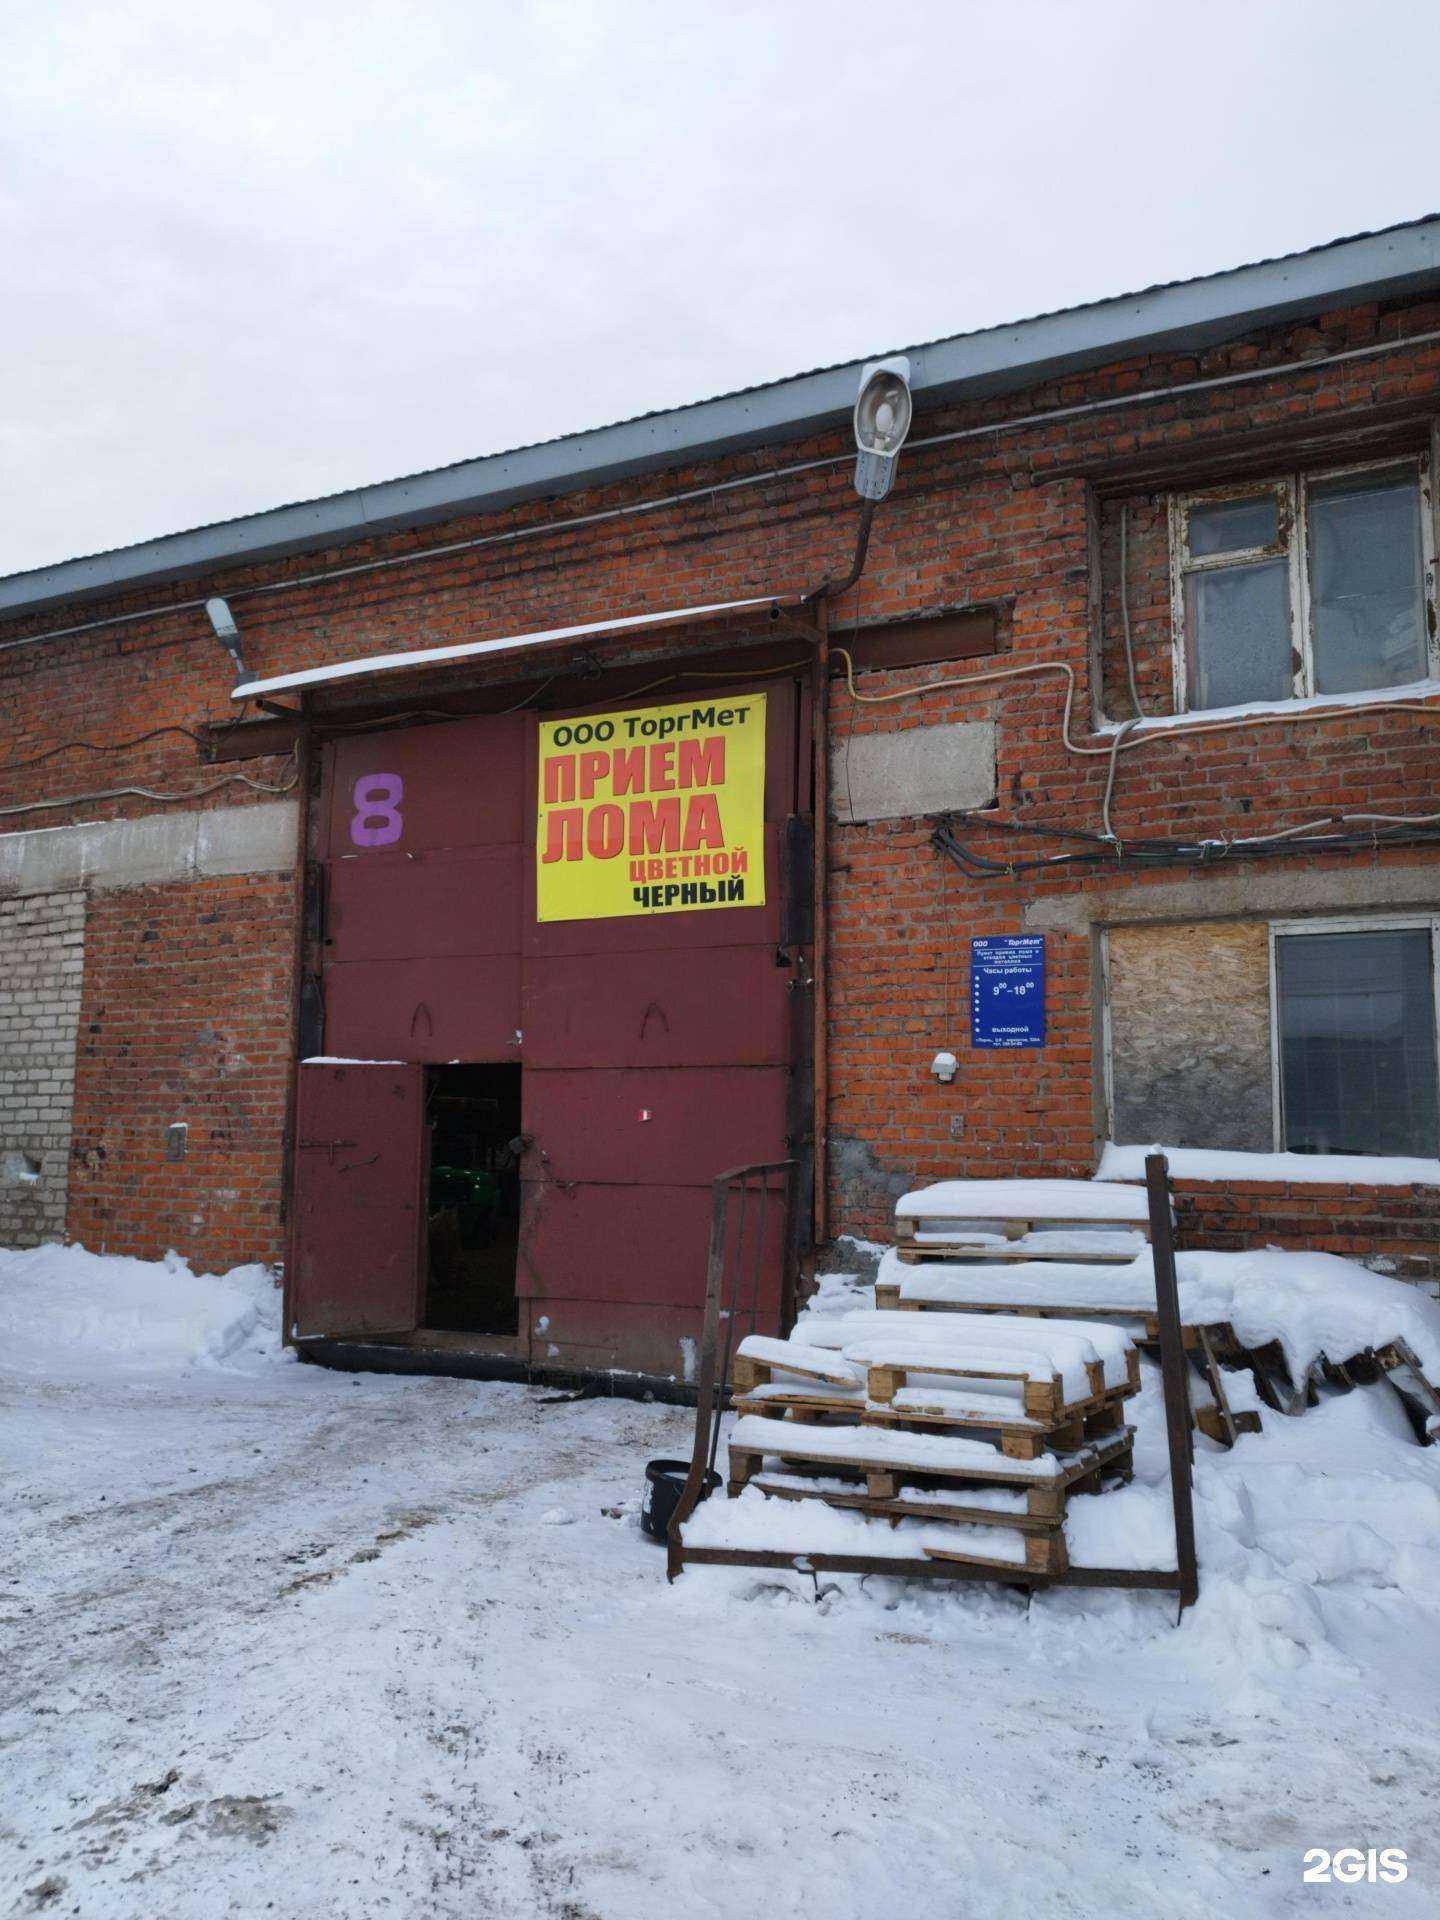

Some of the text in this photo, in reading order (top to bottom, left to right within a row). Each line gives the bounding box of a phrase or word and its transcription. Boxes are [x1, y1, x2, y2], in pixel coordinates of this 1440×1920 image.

[553, 707, 751, 747] ООО ТоргМет
[544, 735, 726, 804] ПРИЕМ
[351, 773, 404, 847] 8
[541, 792, 725, 864] ЛОМА
[629, 846, 748, 884] ЦВЕТНОЙ
[633, 874, 745, 907] ЧЕРНЫЙ
[1004, 967, 1032, 975] работы
[992, 1025, 1029, 1034] выходной
